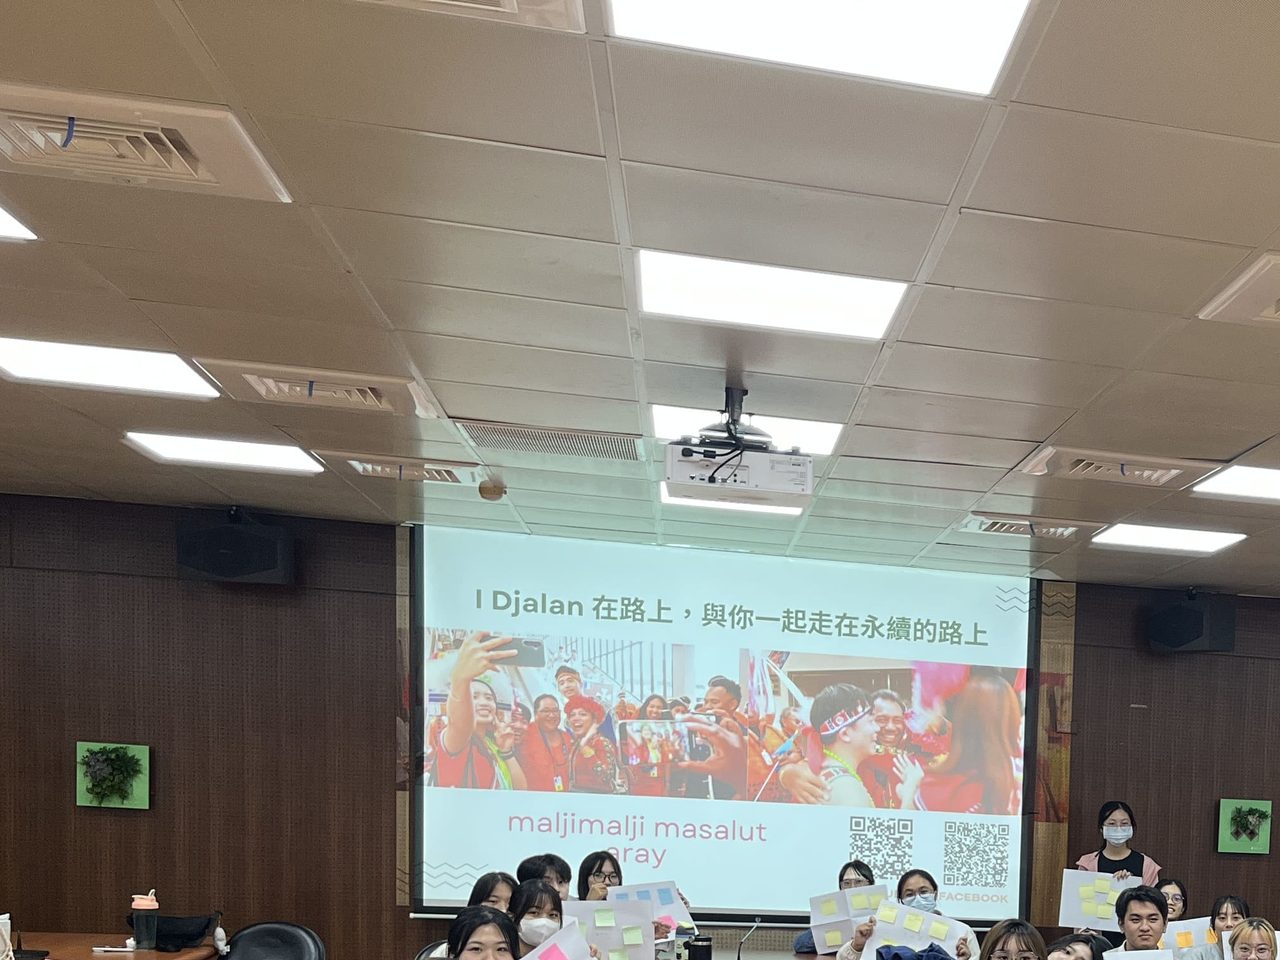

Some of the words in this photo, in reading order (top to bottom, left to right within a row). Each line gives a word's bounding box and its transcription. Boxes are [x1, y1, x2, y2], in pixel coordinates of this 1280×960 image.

[492, 589, 584, 618] Djalan
[592, 594, 989, 647] 在路上，與你一起走在永續的路上
[508, 811, 645, 842] maljimalji
[655, 819, 768, 842] masalut
[939, 891, 1009, 904] FACEBOOK
